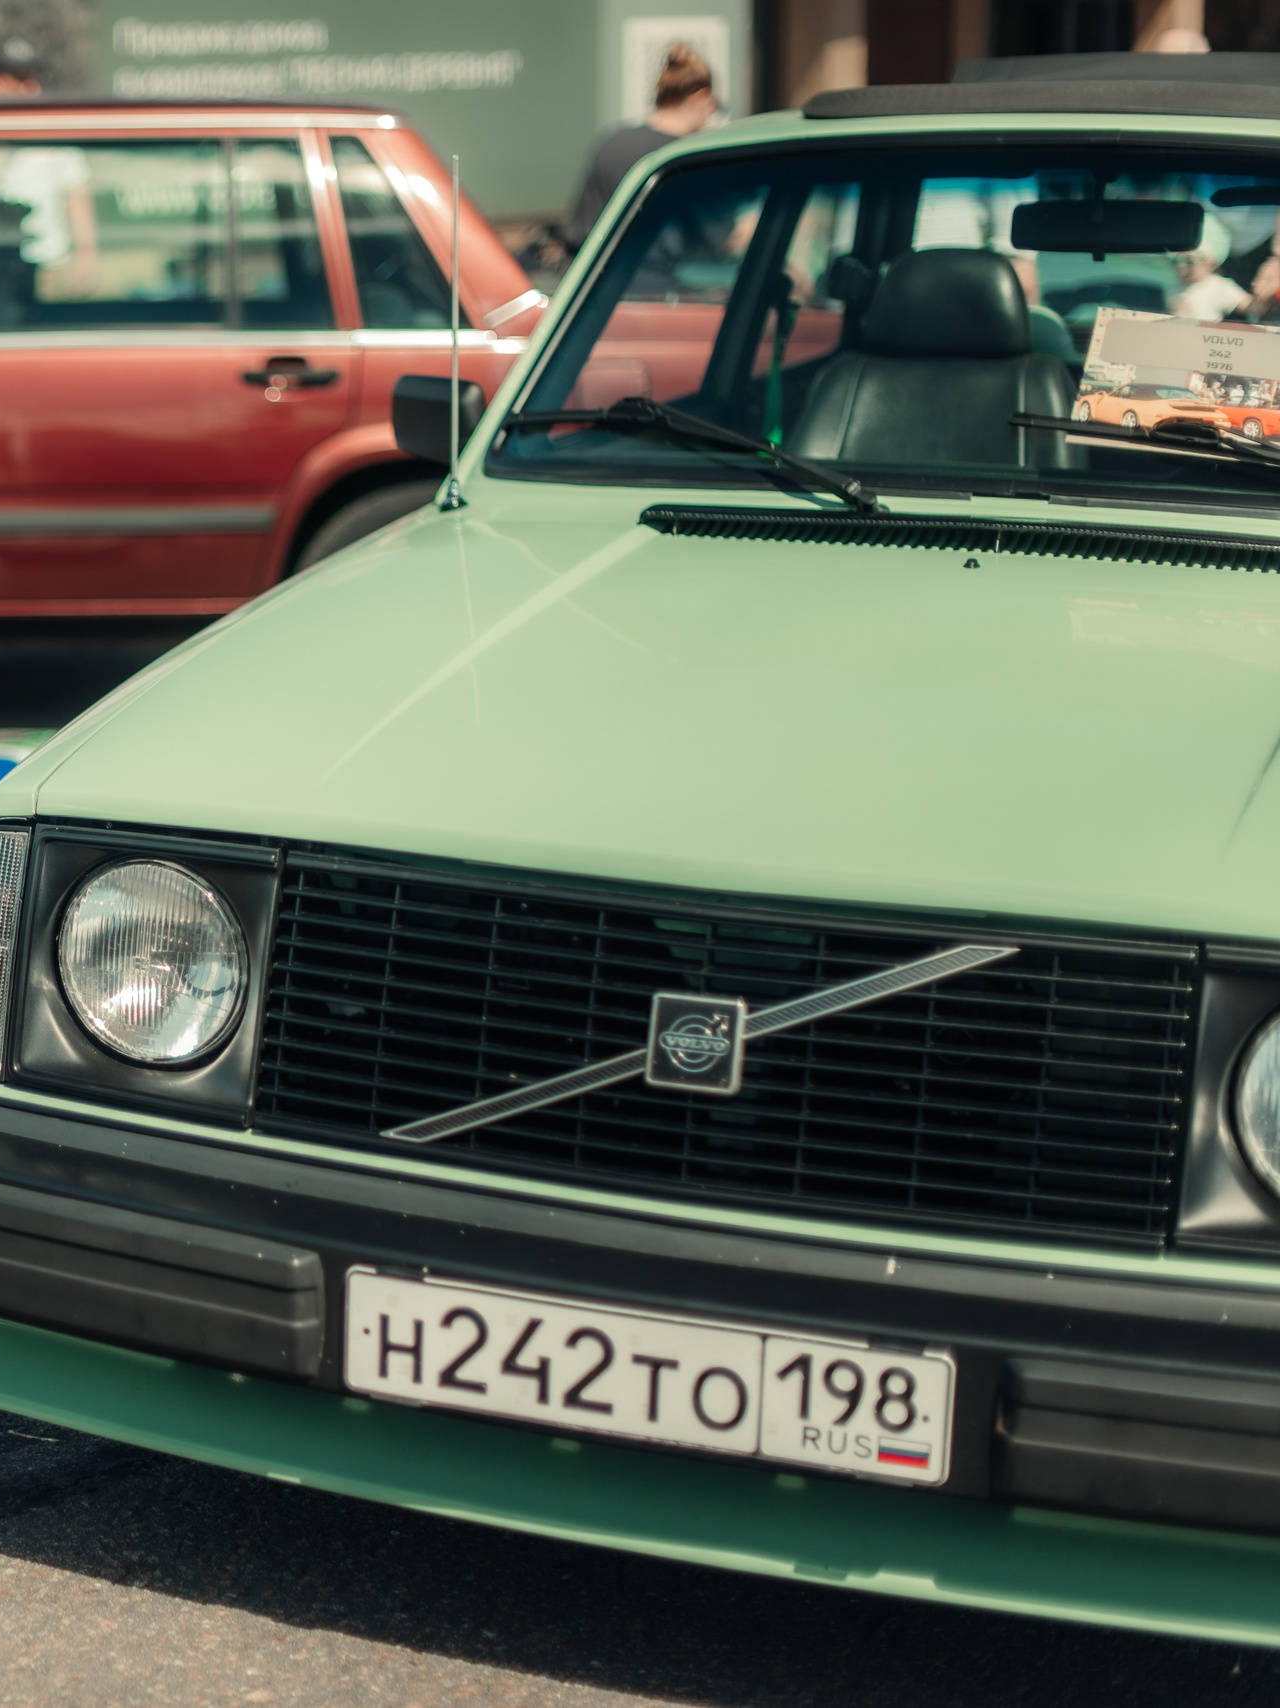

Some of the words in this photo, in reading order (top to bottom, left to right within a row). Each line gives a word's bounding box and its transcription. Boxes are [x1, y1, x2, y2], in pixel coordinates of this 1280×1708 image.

[1202, 334, 1244, 347] VOLVO
[1208, 349, 1232, 359] 242
[1206, 361, 1233, 371] 1976
[664, 1035, 726, 1052] VOLVO
[776, 1353, 917, 1434] 198
[802, 1426, 872, 1459] RUS
